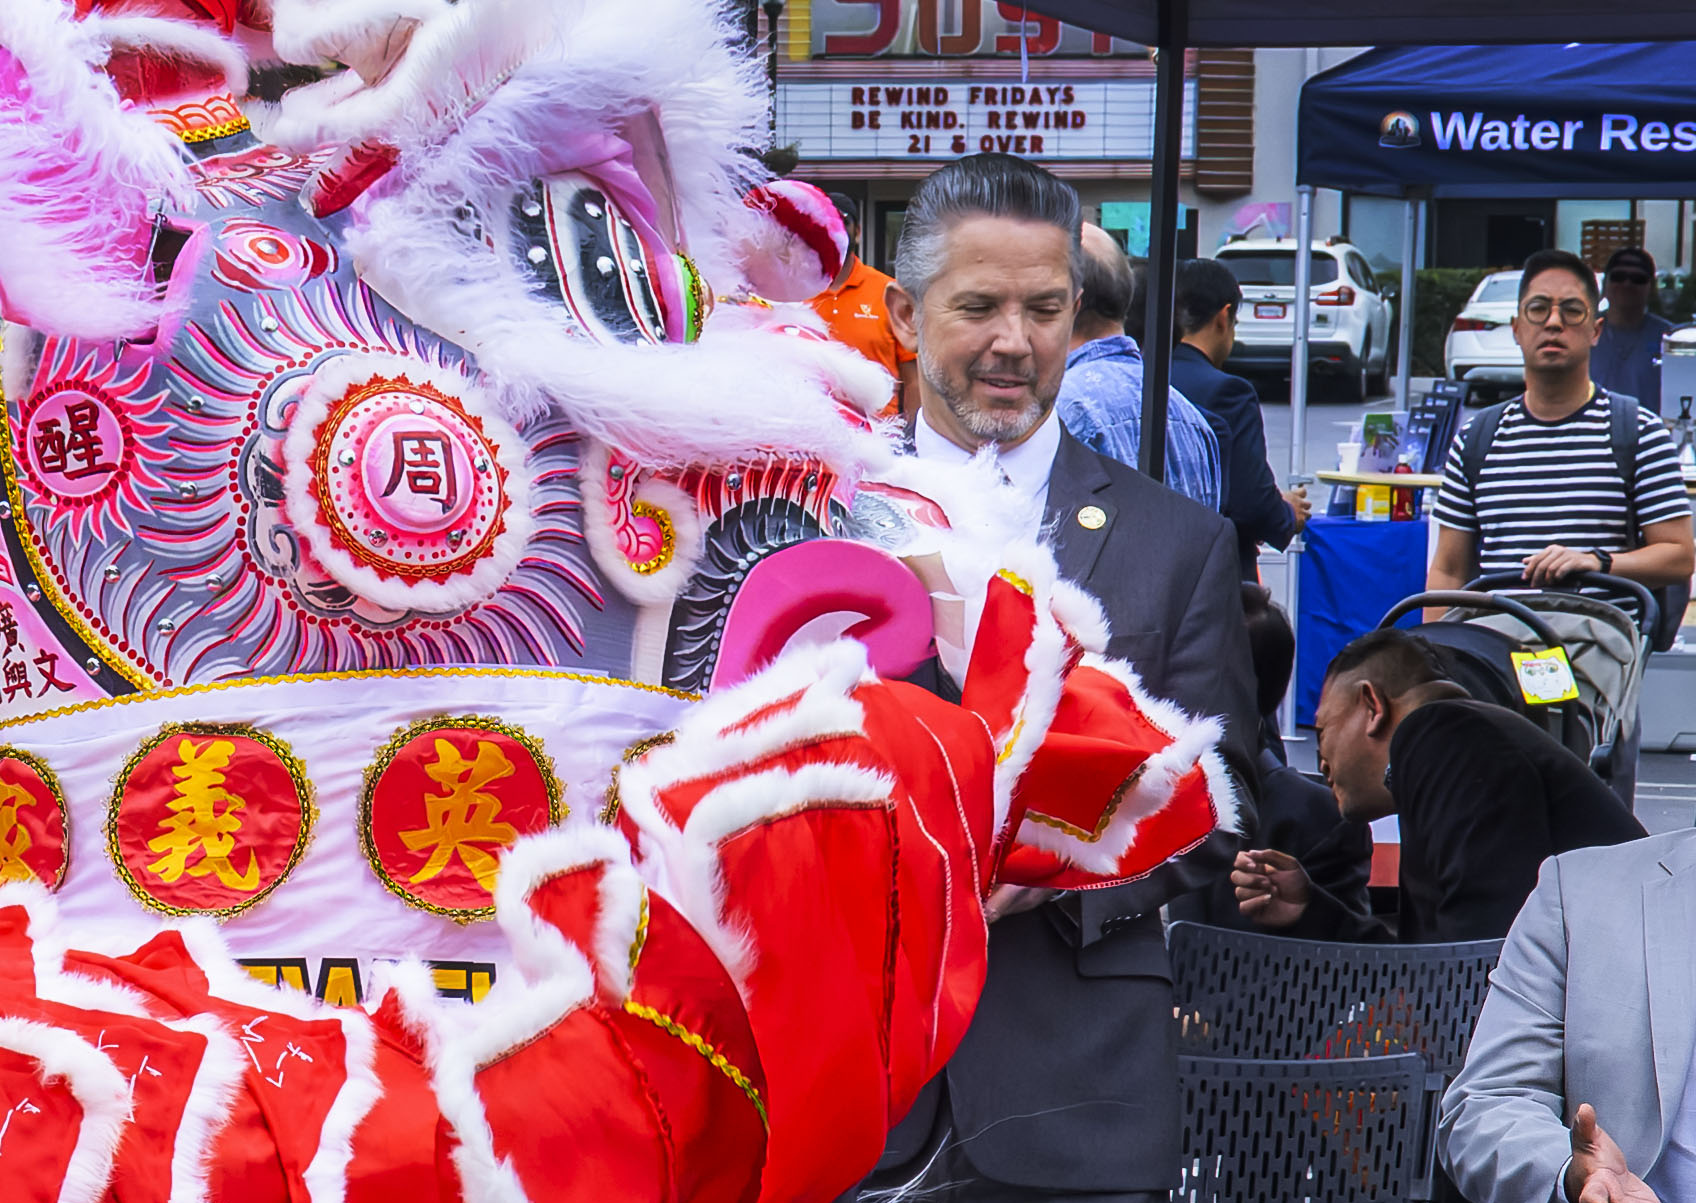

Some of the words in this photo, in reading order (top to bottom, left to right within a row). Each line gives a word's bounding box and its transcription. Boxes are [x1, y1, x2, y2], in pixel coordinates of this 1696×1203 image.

[851, 86, 949, 106] REWIND
[967, 86, 1075, 106] FRIDAYS
[851, 110, 881, 130] BE
[900, 110, 966, 130] KIND.
[986, 110, 1086, 130] REWIND
[1430, 111, 1584, 151] Water
[907, 135, 932, 154] 21
[950, 135, 966, 154] &
[979, 134, 1045, 155] OVER
[33, 400, 119, 481] 醒
[380, 430, 457, 515] 周
[147, 738, 260, 891] 義
[397, 737, 518, 893] 英
